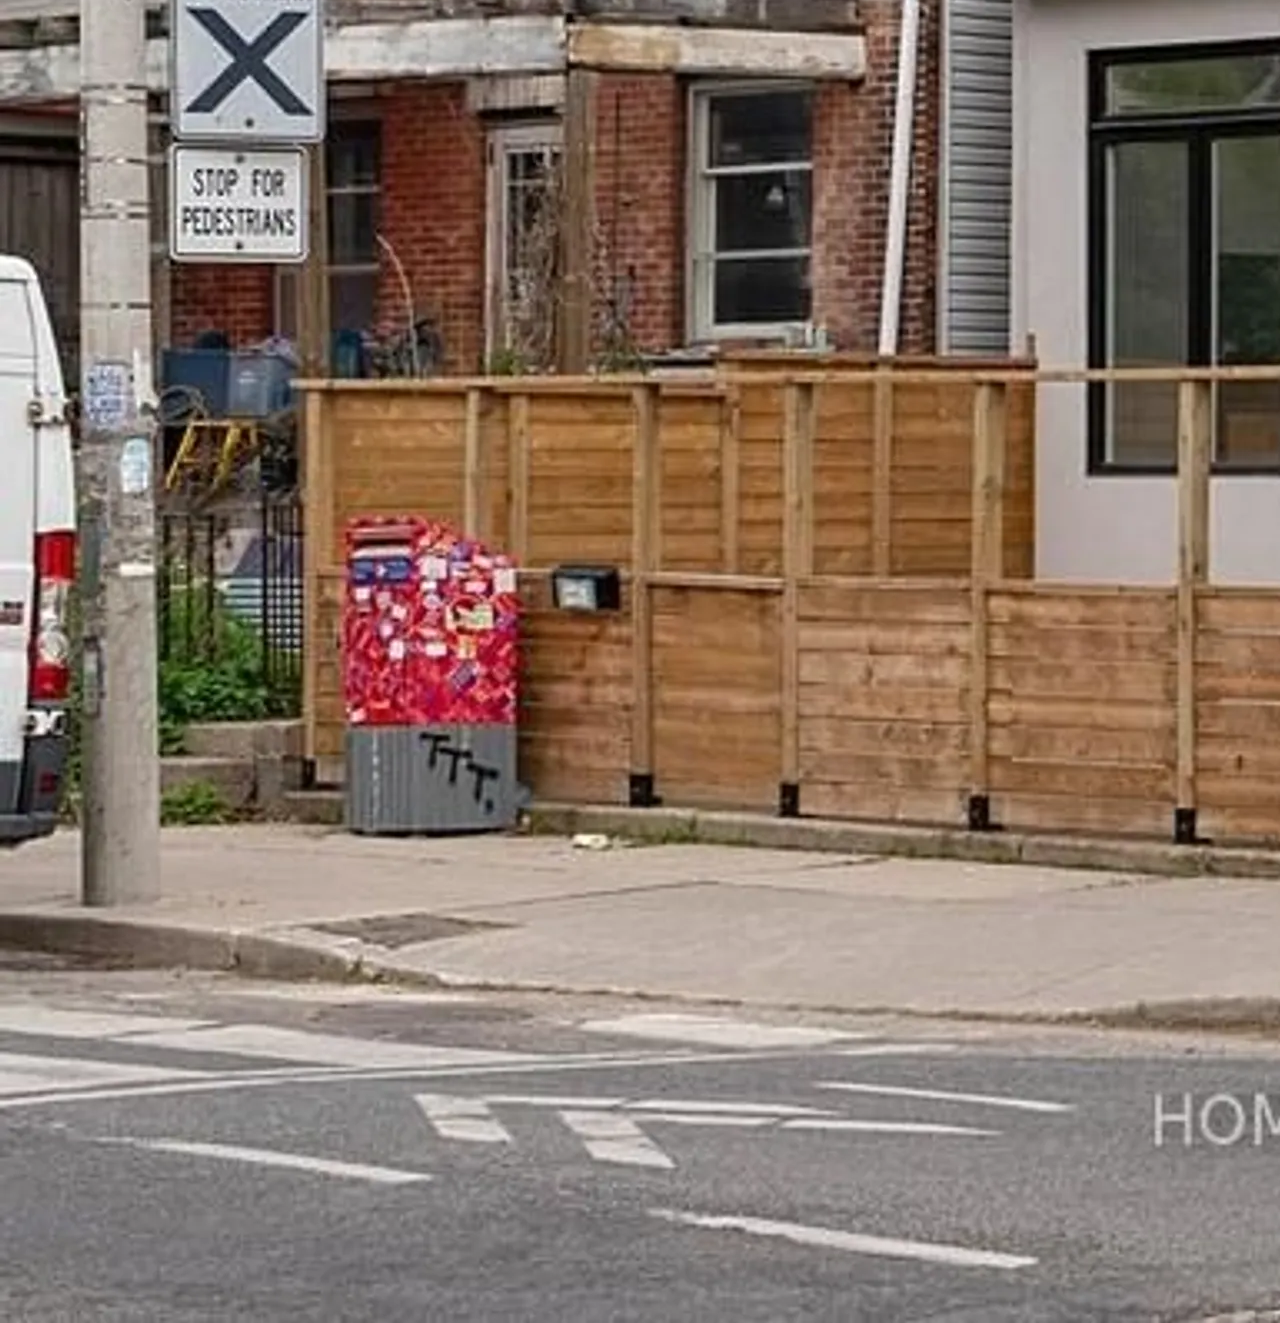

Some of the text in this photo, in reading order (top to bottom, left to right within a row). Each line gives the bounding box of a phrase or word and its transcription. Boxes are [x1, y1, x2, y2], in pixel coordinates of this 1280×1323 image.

[193, 168, 285, 197] STOP FOR
[182, 206, 295, 237] PEDESTRIANS
